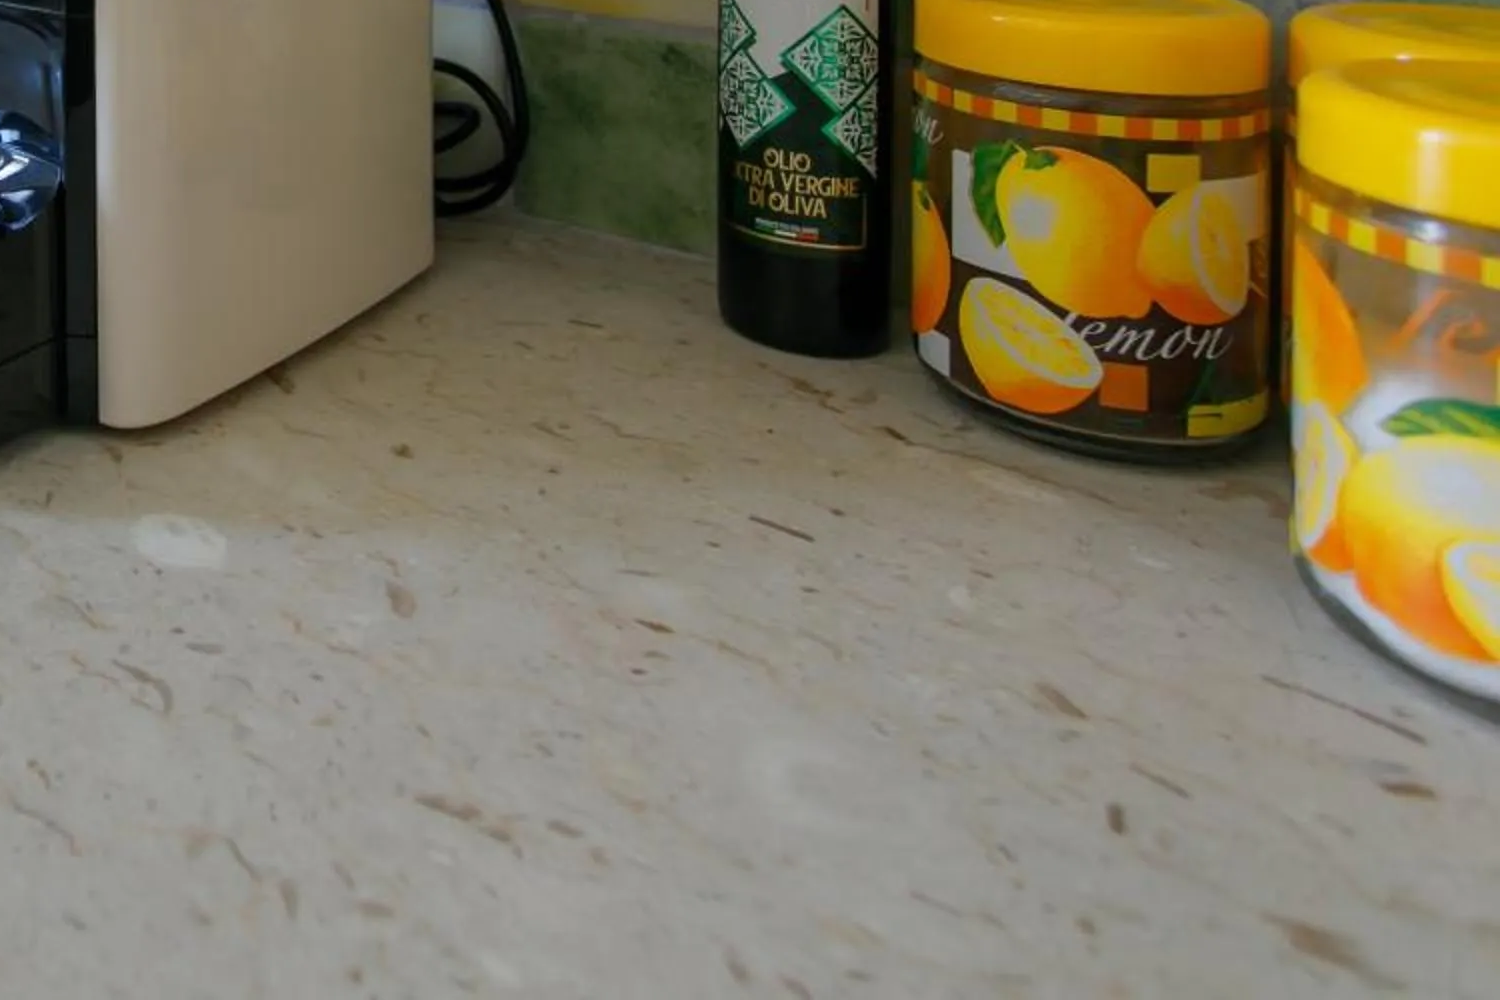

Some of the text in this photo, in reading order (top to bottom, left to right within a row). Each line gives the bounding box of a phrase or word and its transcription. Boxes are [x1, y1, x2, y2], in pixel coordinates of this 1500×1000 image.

[763, 147, 812, 173] OLIO
[780, 173, 860, 197] VERGINE
[748, 186, 828, 219] DI OLIVA
